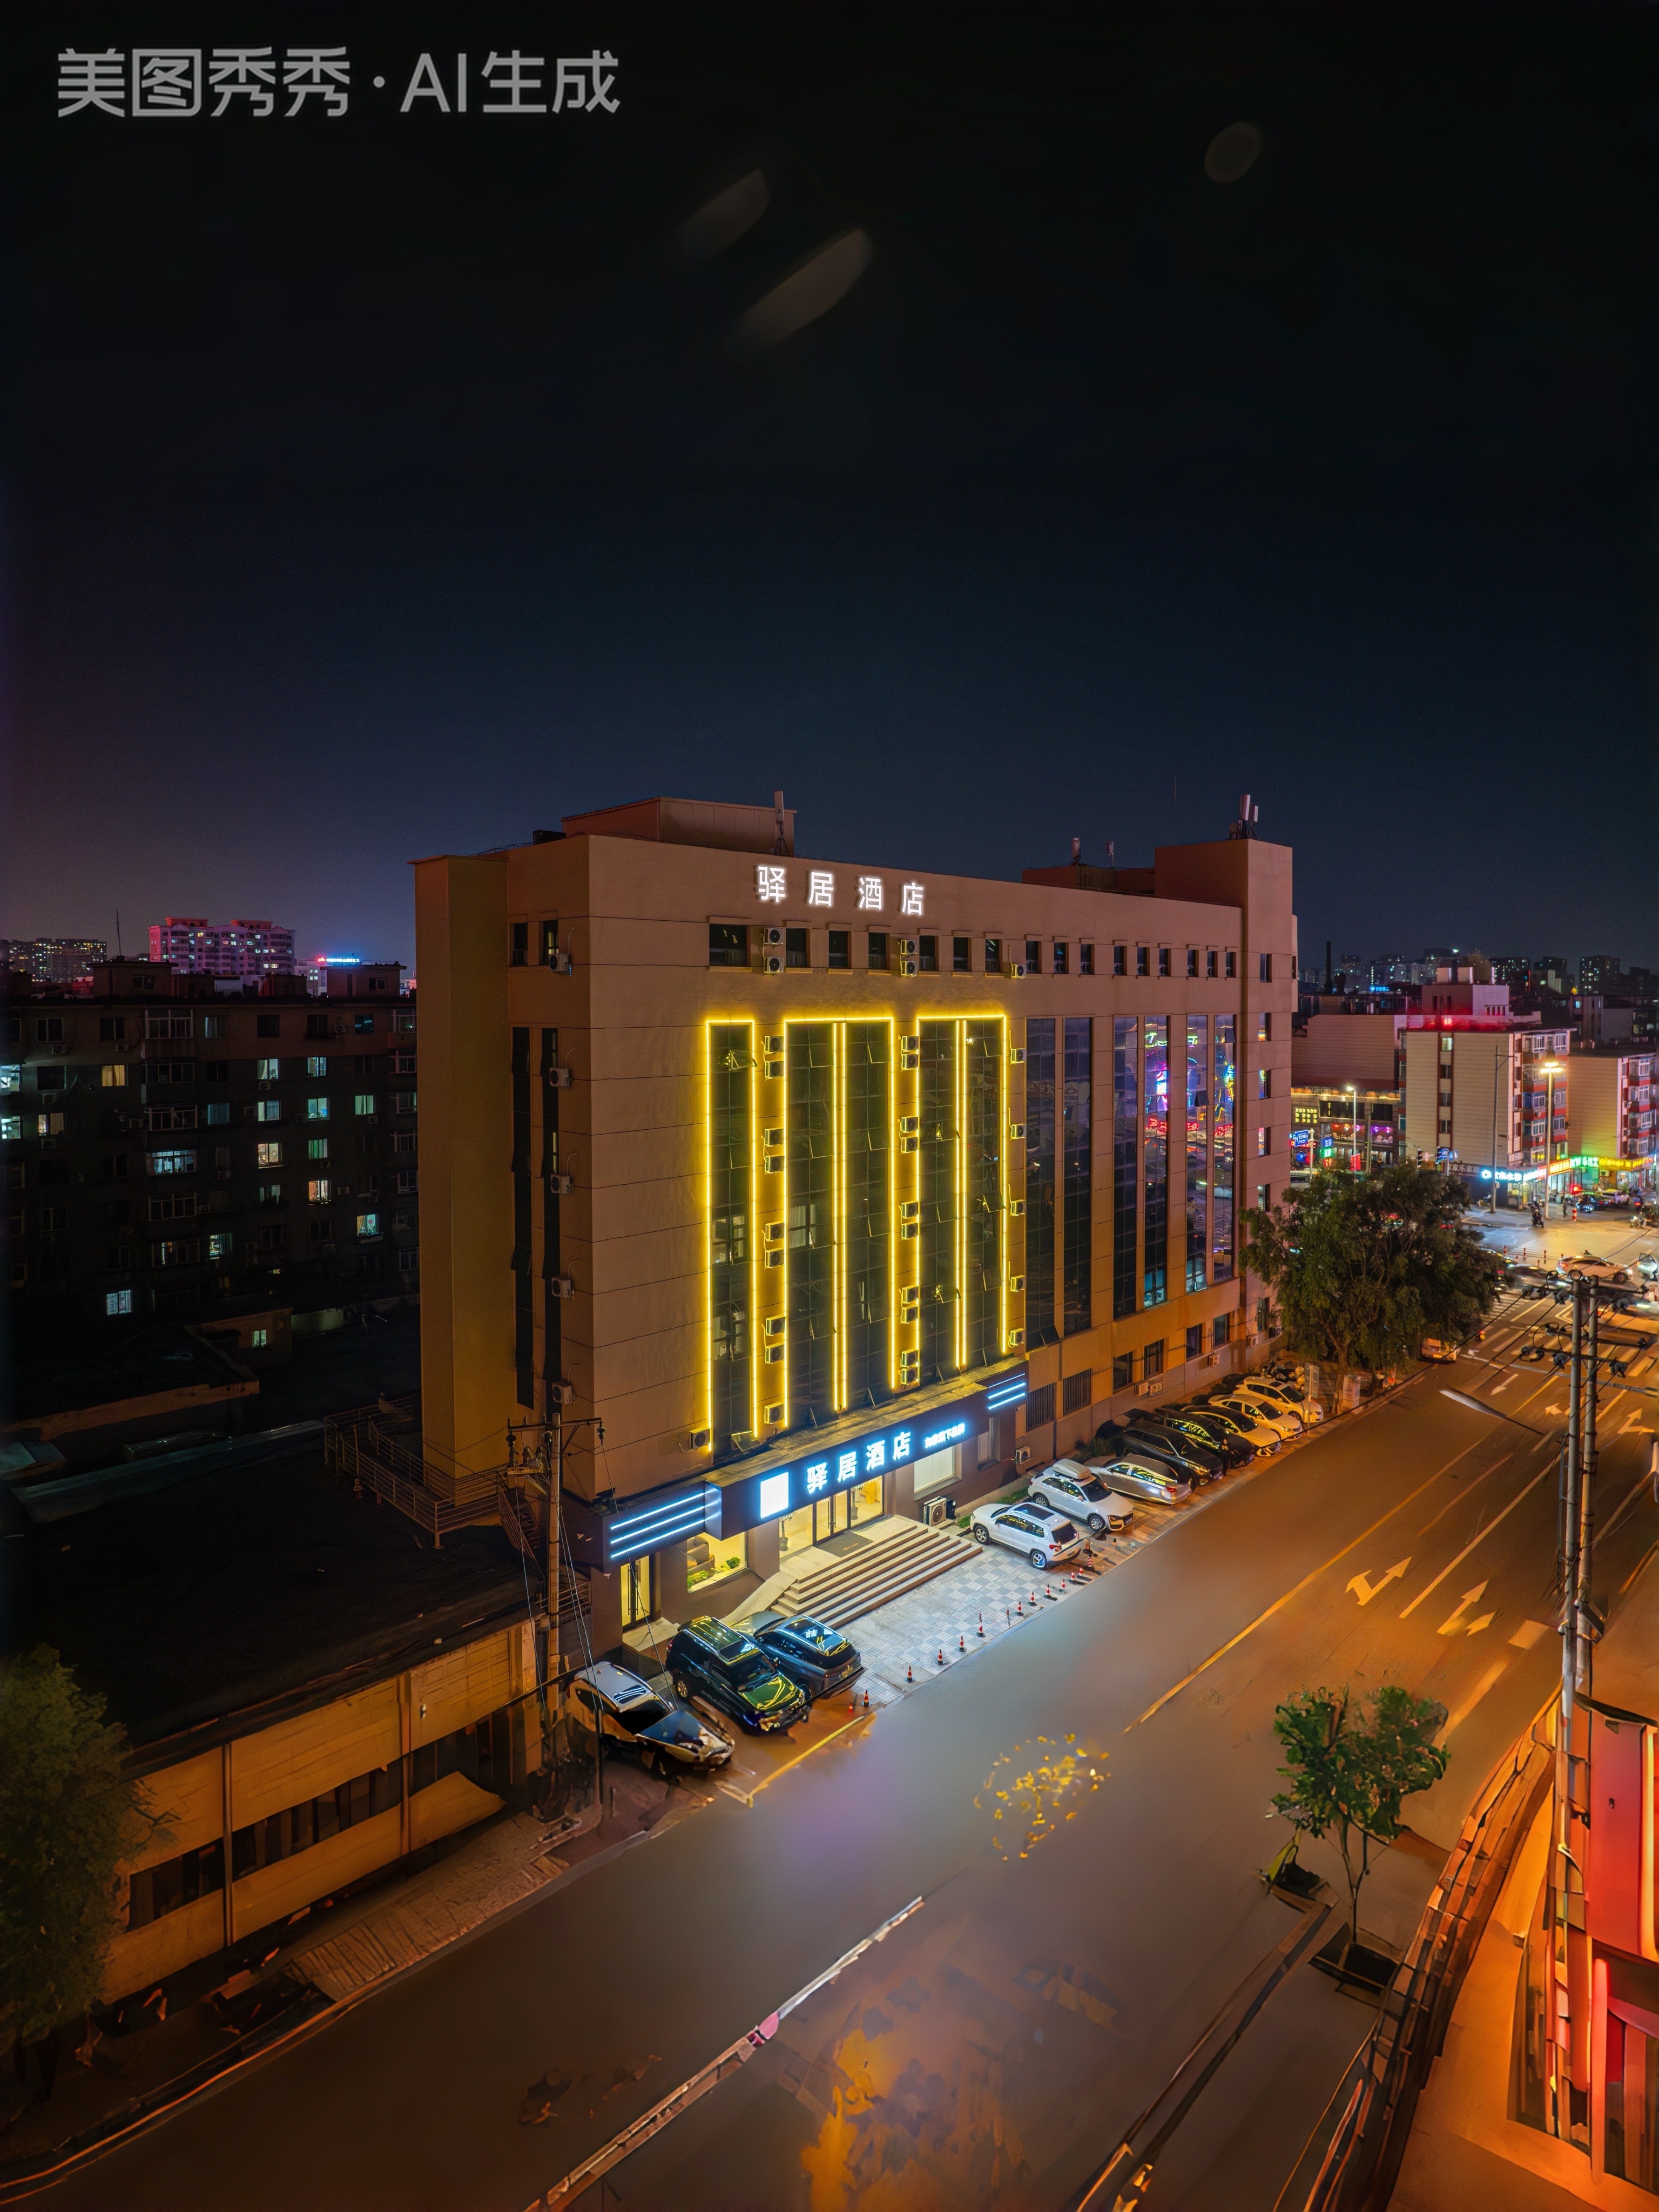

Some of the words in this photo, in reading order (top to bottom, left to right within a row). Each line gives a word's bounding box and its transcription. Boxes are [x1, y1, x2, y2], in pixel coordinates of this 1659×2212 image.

[758, 866, 924, 915] 驿居酒店
[806, 1431, 912, 1494] 驿居酒店
